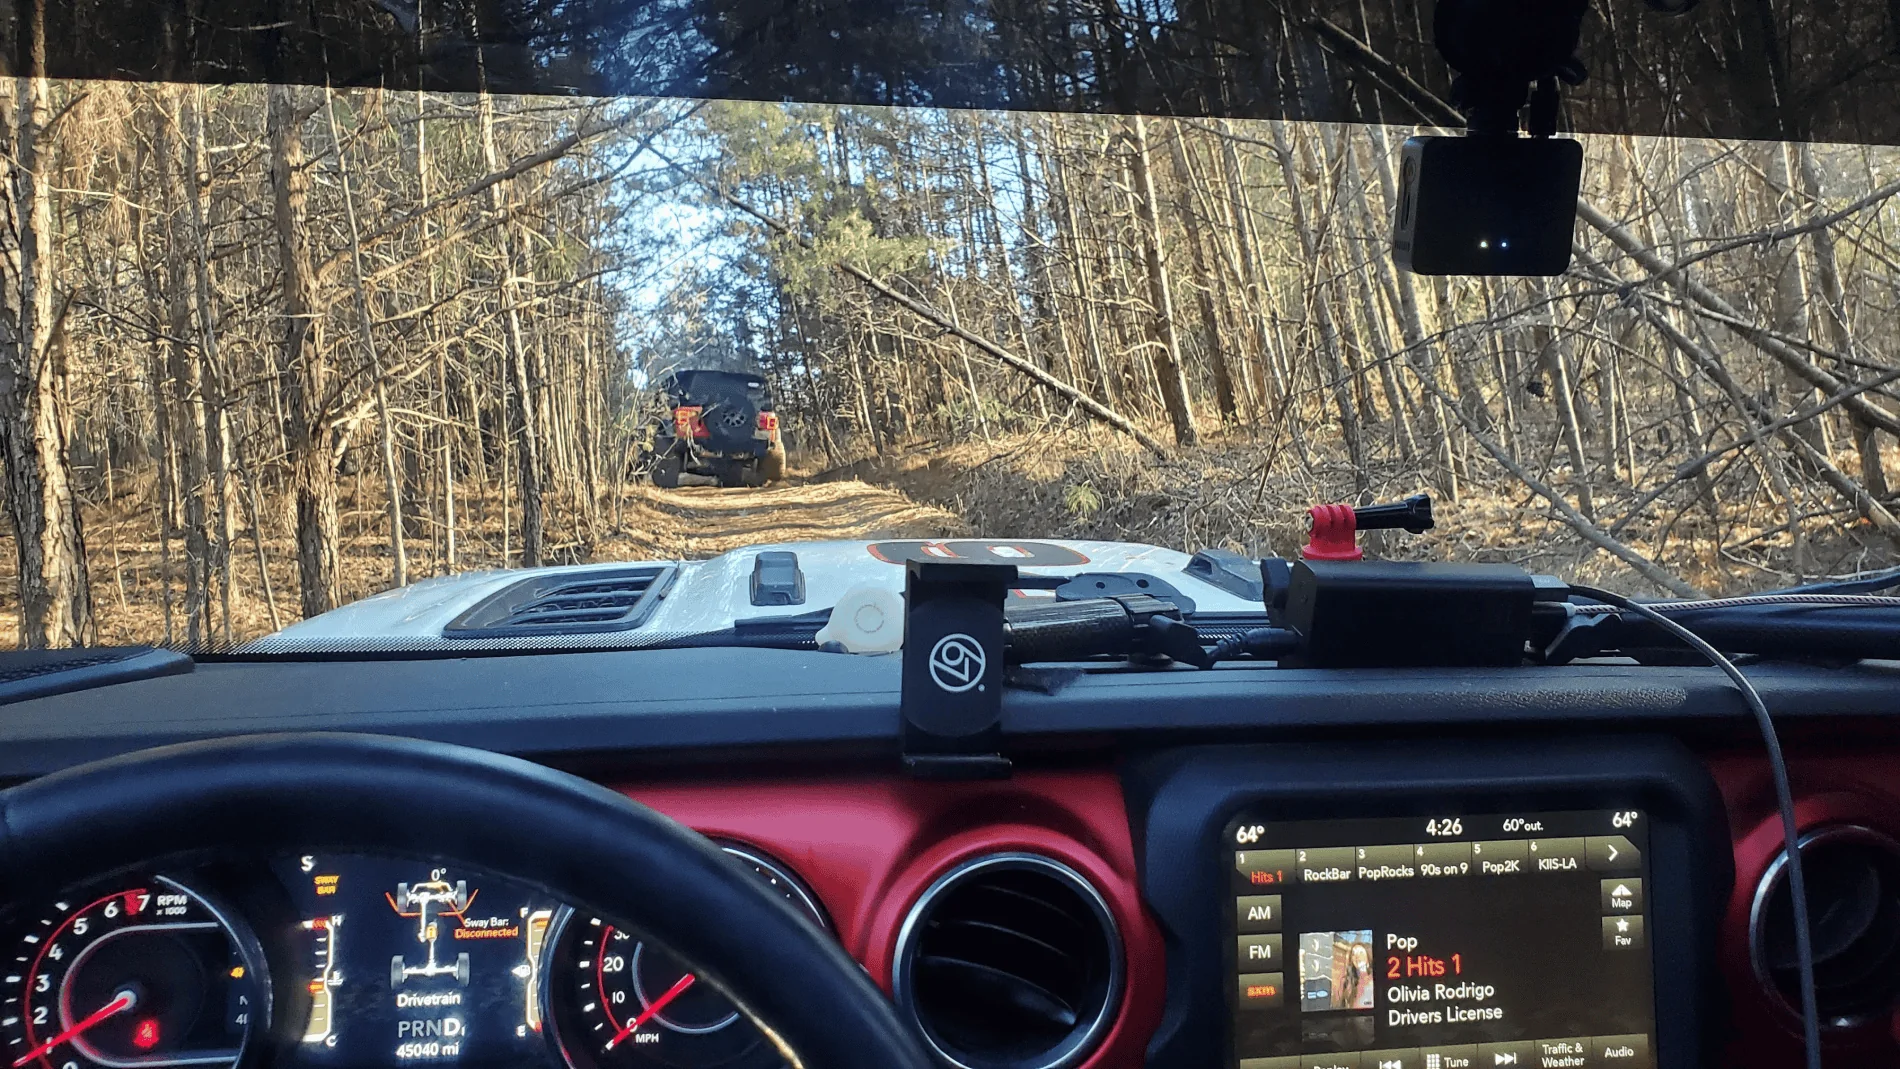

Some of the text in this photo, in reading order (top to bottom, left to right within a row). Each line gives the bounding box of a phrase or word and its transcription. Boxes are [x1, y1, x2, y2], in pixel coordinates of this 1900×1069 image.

[1612, 811, 1638, 828] 64°
[1425, 818, 1463, 836] 4:26
[1236, 825, 1265, 843] 64°
[1416, 846, 1423, 856] 4
[1474, 844, 1481, 854] 5
[1530, 841, 1537, 851] 6
[1240, 854, 1245, 864] 1
[1300, 851, 1306, 861] 2
[1358, 849, 1365, 859] 3
[301, 855, 314, 872] S
[1421, 862, 1468, 876] 90s on 9
[1482, 860, 1519, 875] Pop2K
[1538, 857, 1577, 871] KIIS-LA
[1251, 870, 1283, 883] Hits 1
[1304, 868, 1351, 881] RockBar
[1358, 865, 1414, 881] PopRocks
[137, 895, 150, 912] 7
[157, 895, 187, 906] RPM
[1611, 898, 1632, 909] Map
[104, 902, 117, 918] 6
[164, 907, 187, 915] 1000
[520, 907, 528, 918] F
[1247, 906, 1271, 921] AM
[73, 918, 89, 935] 5
[332, 915, 342, 926] H
[464, 917, 509, 929] Sway Bar:
[455, 926, 519, 939] Disconnected
[1387, 933, 1418, 952] Pop
[1615, 936, 1631, 946] Fav
[48, 944, 63, 961] 4
[1249, 945, 1271, 960] FM
[603, 956, 624, 972] 20
[1387, 953, 1461, 978] 2 Hits 1
[36, 975, 50, 992] 3
[612, 991, 625, 1004] 10
[1387, 982, 1495, 1003] Olivia Rodrigo
[397, 992, 461, 1007] Drivetrain
[33, 1007, 47, 1024] 2
[1388, 1005, 1503, 1026] Drivers License
[517, 1025, 526, 1036] E
[326, 1035, 337, 1047] C
[635, 1033, 659, 1043] MPH
[396, 1042, 460, 1058] 45040 mi
[1542, 1043, 1583, 1055] Traffic &
[1604, 1046, 1634, 1058] Audio
[1444, 1056, 1469, 1068] Tune
[1542, 1056, 1585, 1068] Weather
